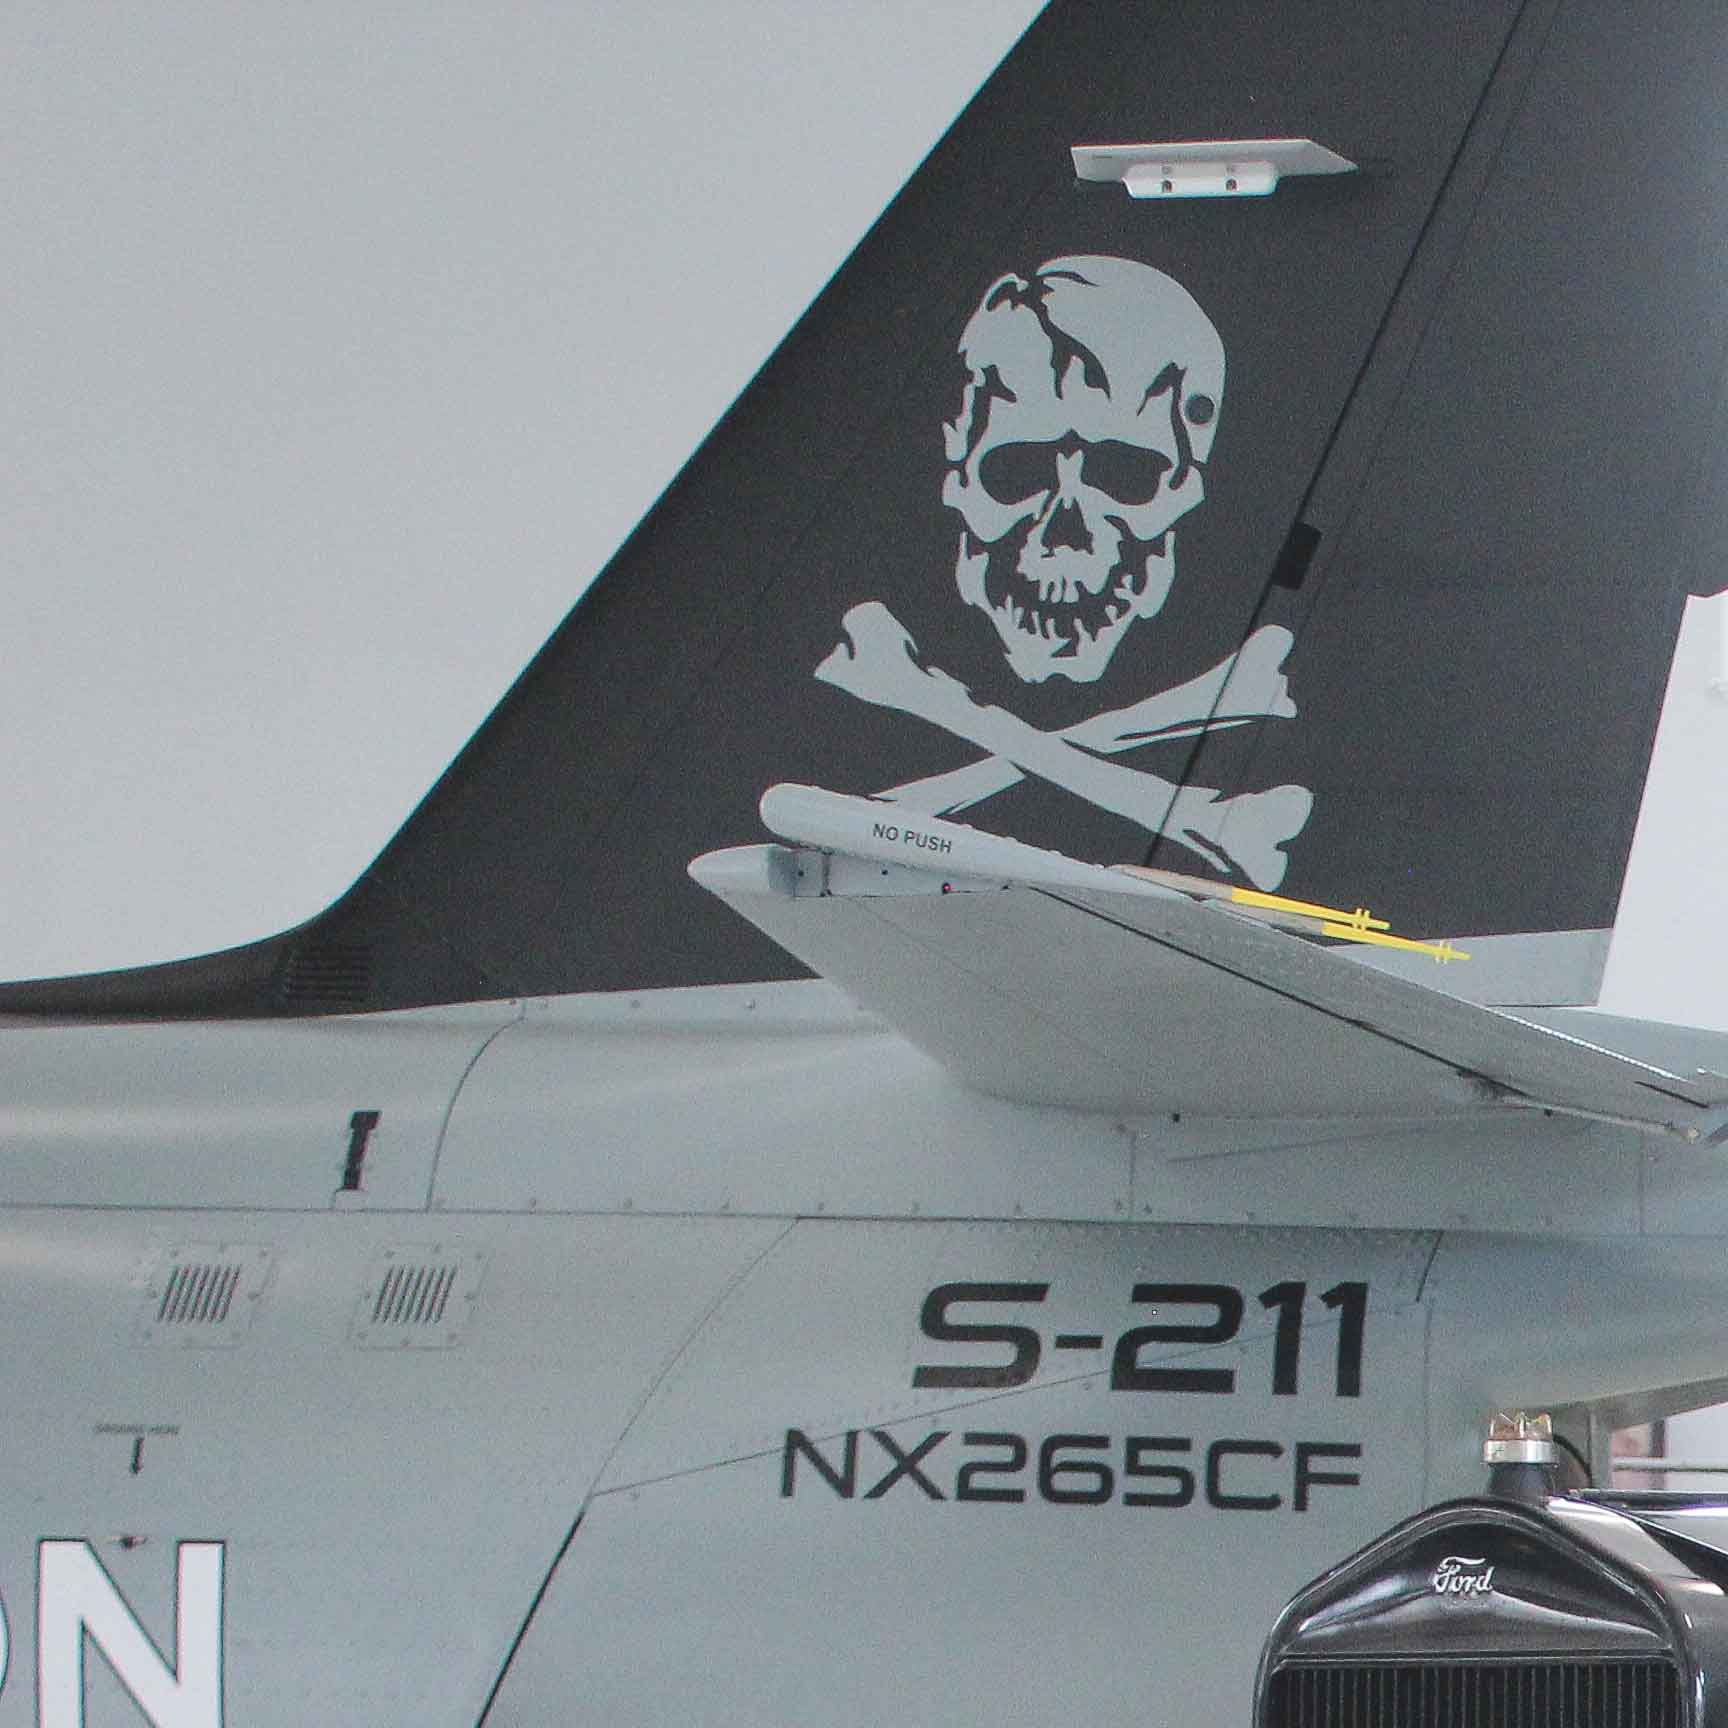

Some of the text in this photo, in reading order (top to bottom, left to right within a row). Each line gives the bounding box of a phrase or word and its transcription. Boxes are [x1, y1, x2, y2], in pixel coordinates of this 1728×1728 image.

[872, 823, 952, 853] NO PUSH
[911, 1281, 1369, 1398] S-211
[779, 1428, 1363, 1513] NX265CF
[1433, 1556, 1495, 1593] Ford
